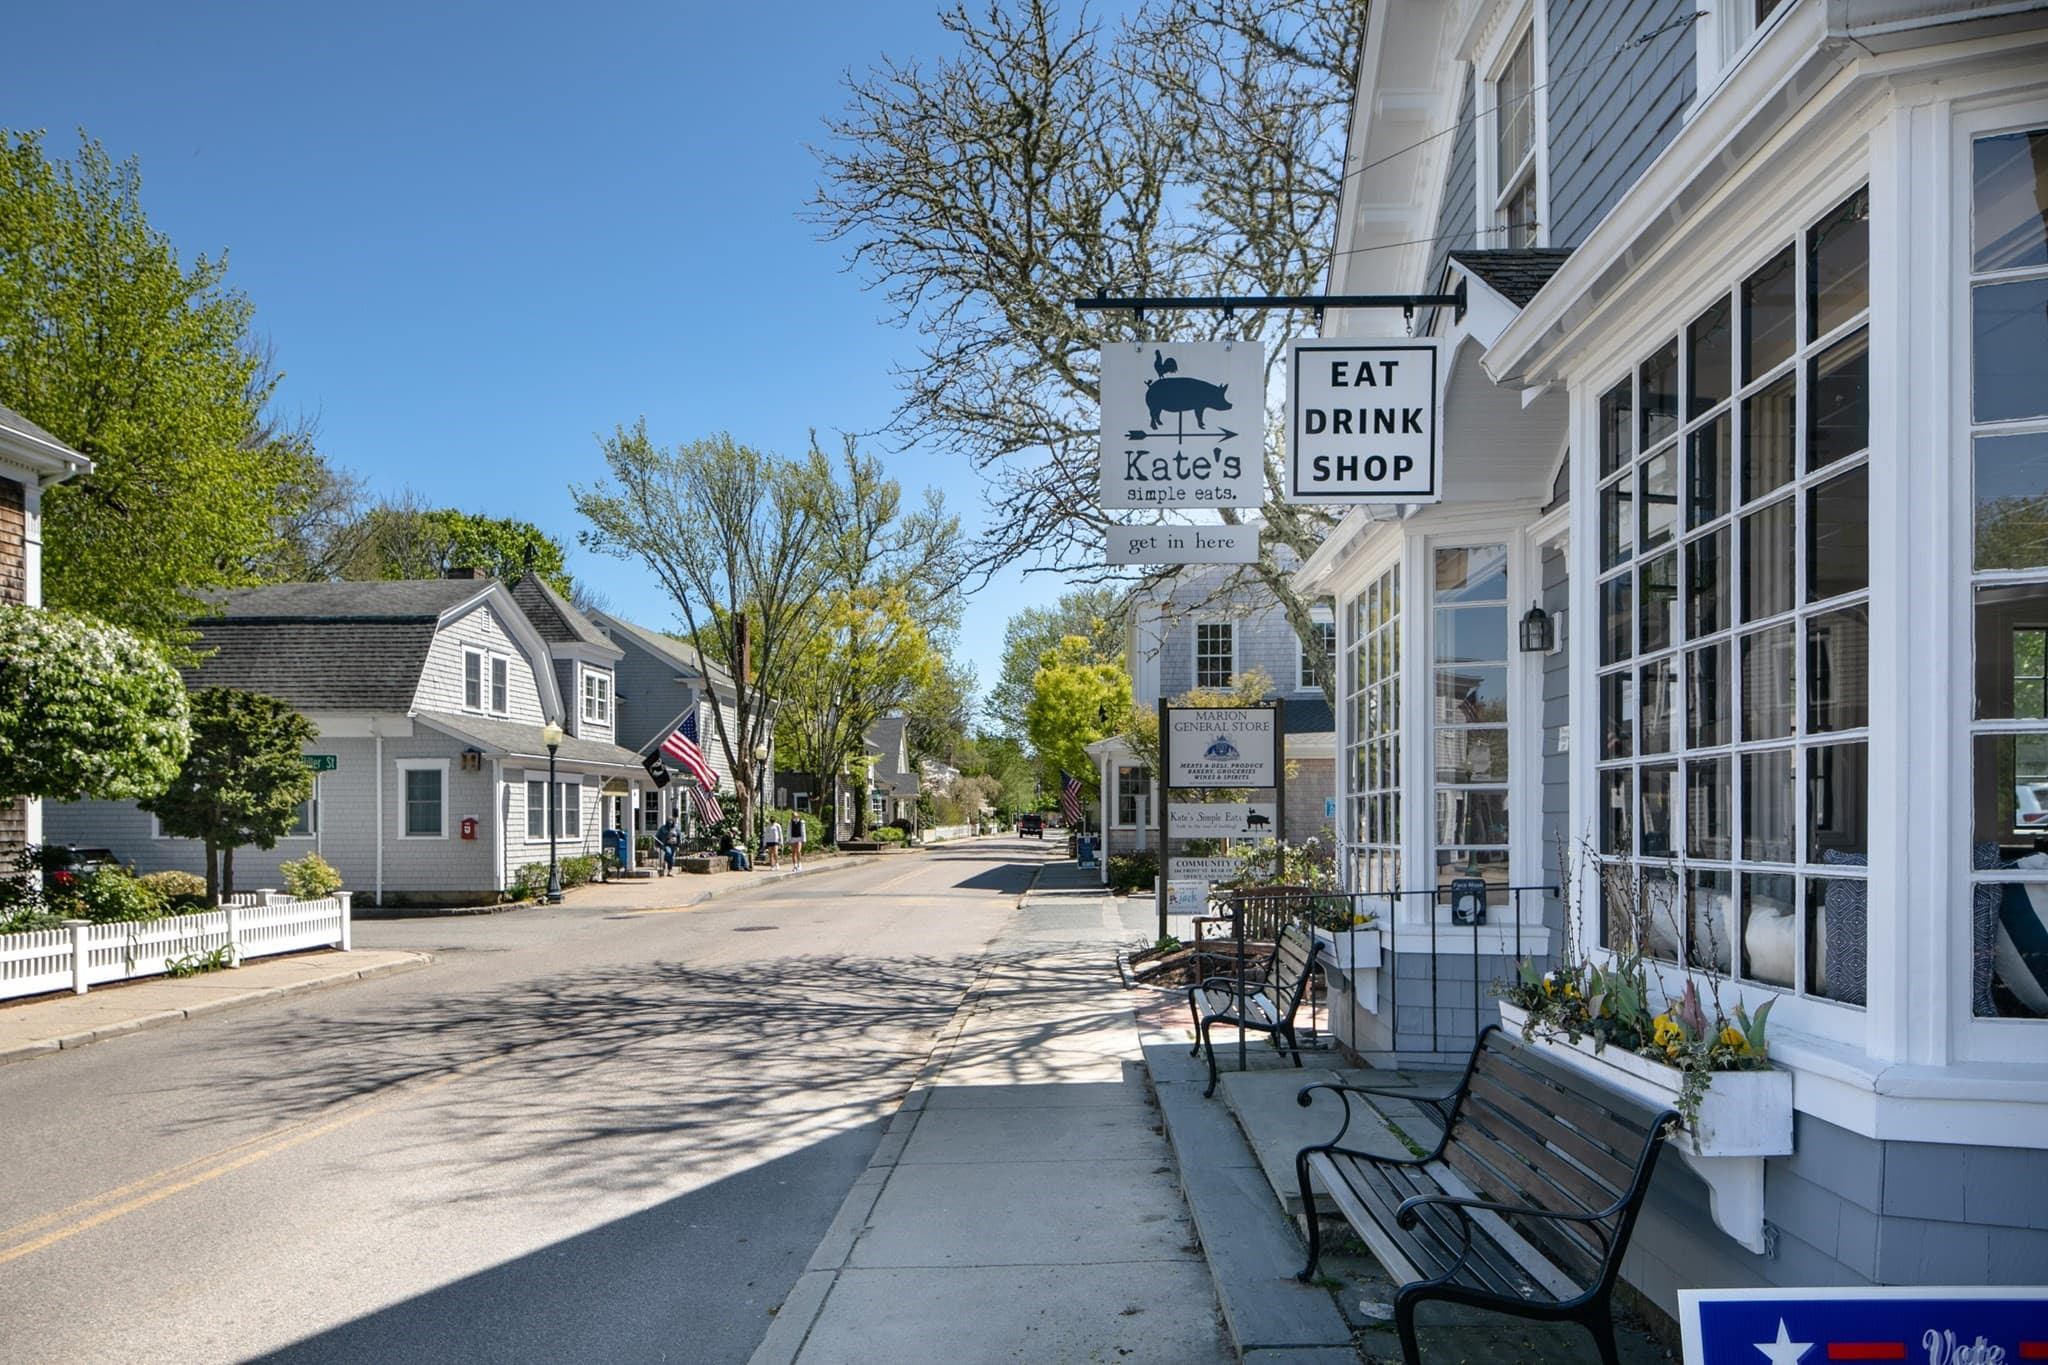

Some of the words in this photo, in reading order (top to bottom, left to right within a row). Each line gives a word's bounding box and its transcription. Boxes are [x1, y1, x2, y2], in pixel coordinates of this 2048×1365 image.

[1331, 361, 1399, 387] EAT
[1305, 408, 1424, 434] DRINK
[1124, 447, 1241, 481] Kate's
[1313, 455, 1414, 482] SHOP
[1127, 486, 1186, 502] simple
[1195, 487, 1237, 500] eats.
[1129, 536, 1159, 555] get
[1168, 534, 1184, 549] in
[1195, 532, 1235, 549] here
[1174, 722, 1229, 732] GENERAL
[1232, 721, 1270, 731] STORE
[1196, 711, 1248, 721] MARION
[326, 756, 335, 769] St
[1170, 811, 1194, 821] Kate's
[1225, 811, 1242, 821] Eats
[1922, 1328, 2006, 1365] Vote
